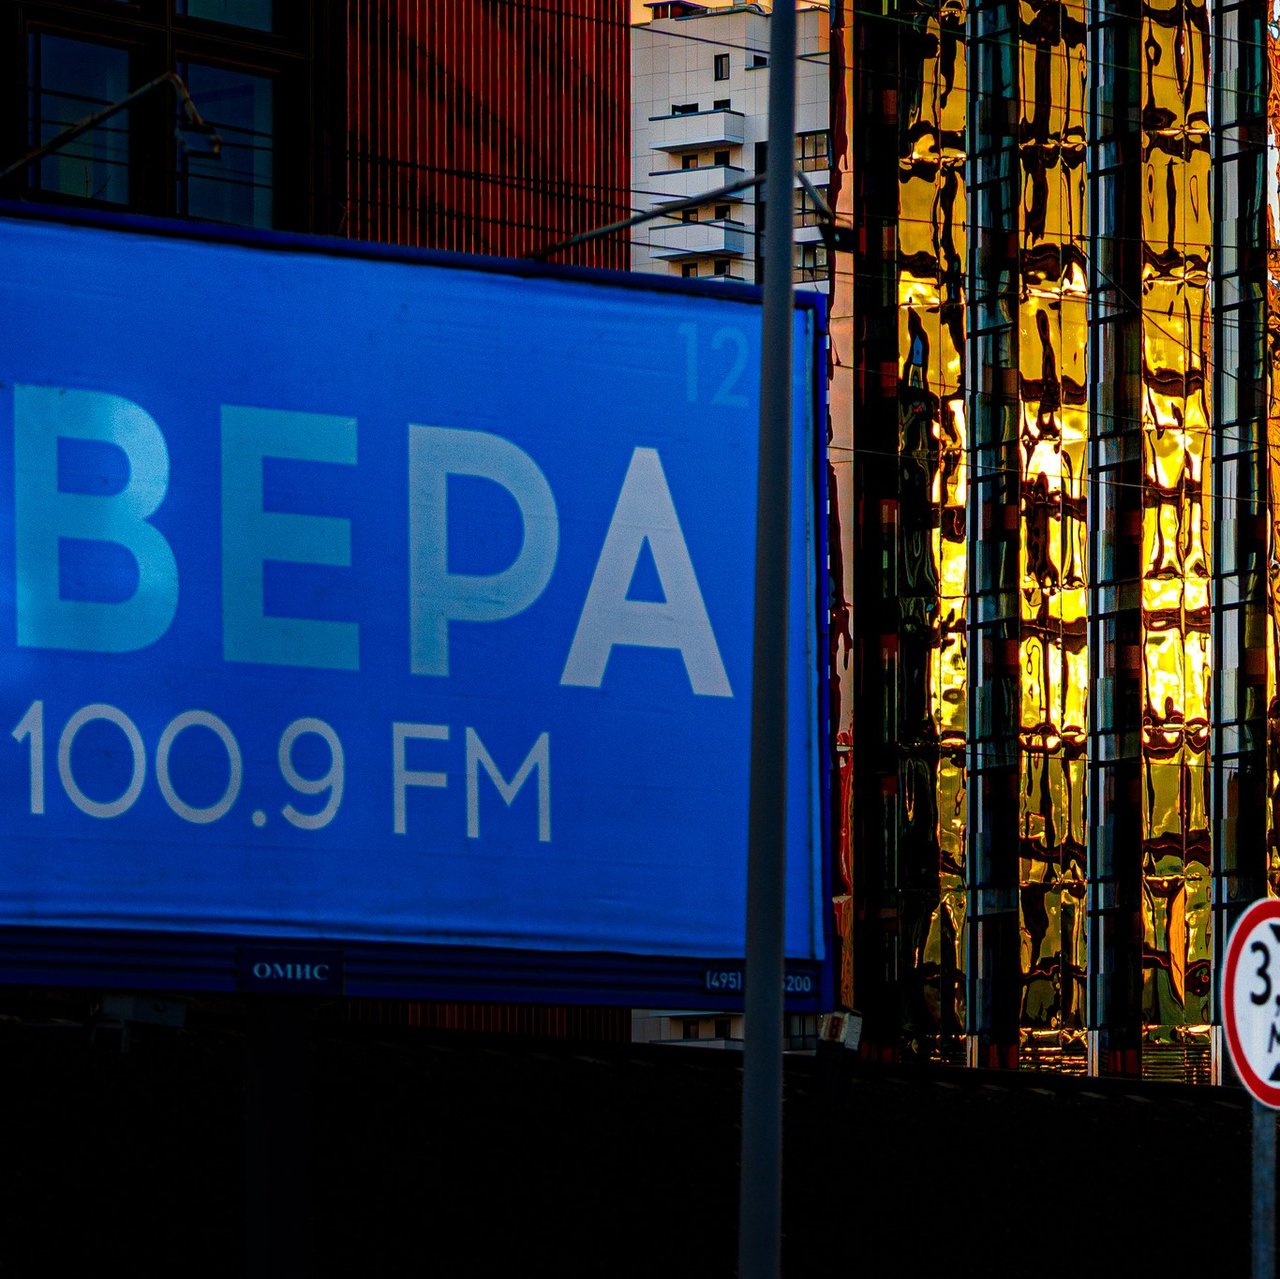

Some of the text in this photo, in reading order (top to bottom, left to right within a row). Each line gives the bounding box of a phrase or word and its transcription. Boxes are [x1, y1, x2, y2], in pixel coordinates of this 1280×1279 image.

[679, 322, 749, 407] 12
[14, 383, 734, 698] ВЕРА
[11, 700, 552, 843] 100.9 FM
[253, 962, 330, 980] ОМИС
[706, 970, 742, 990] (495)
